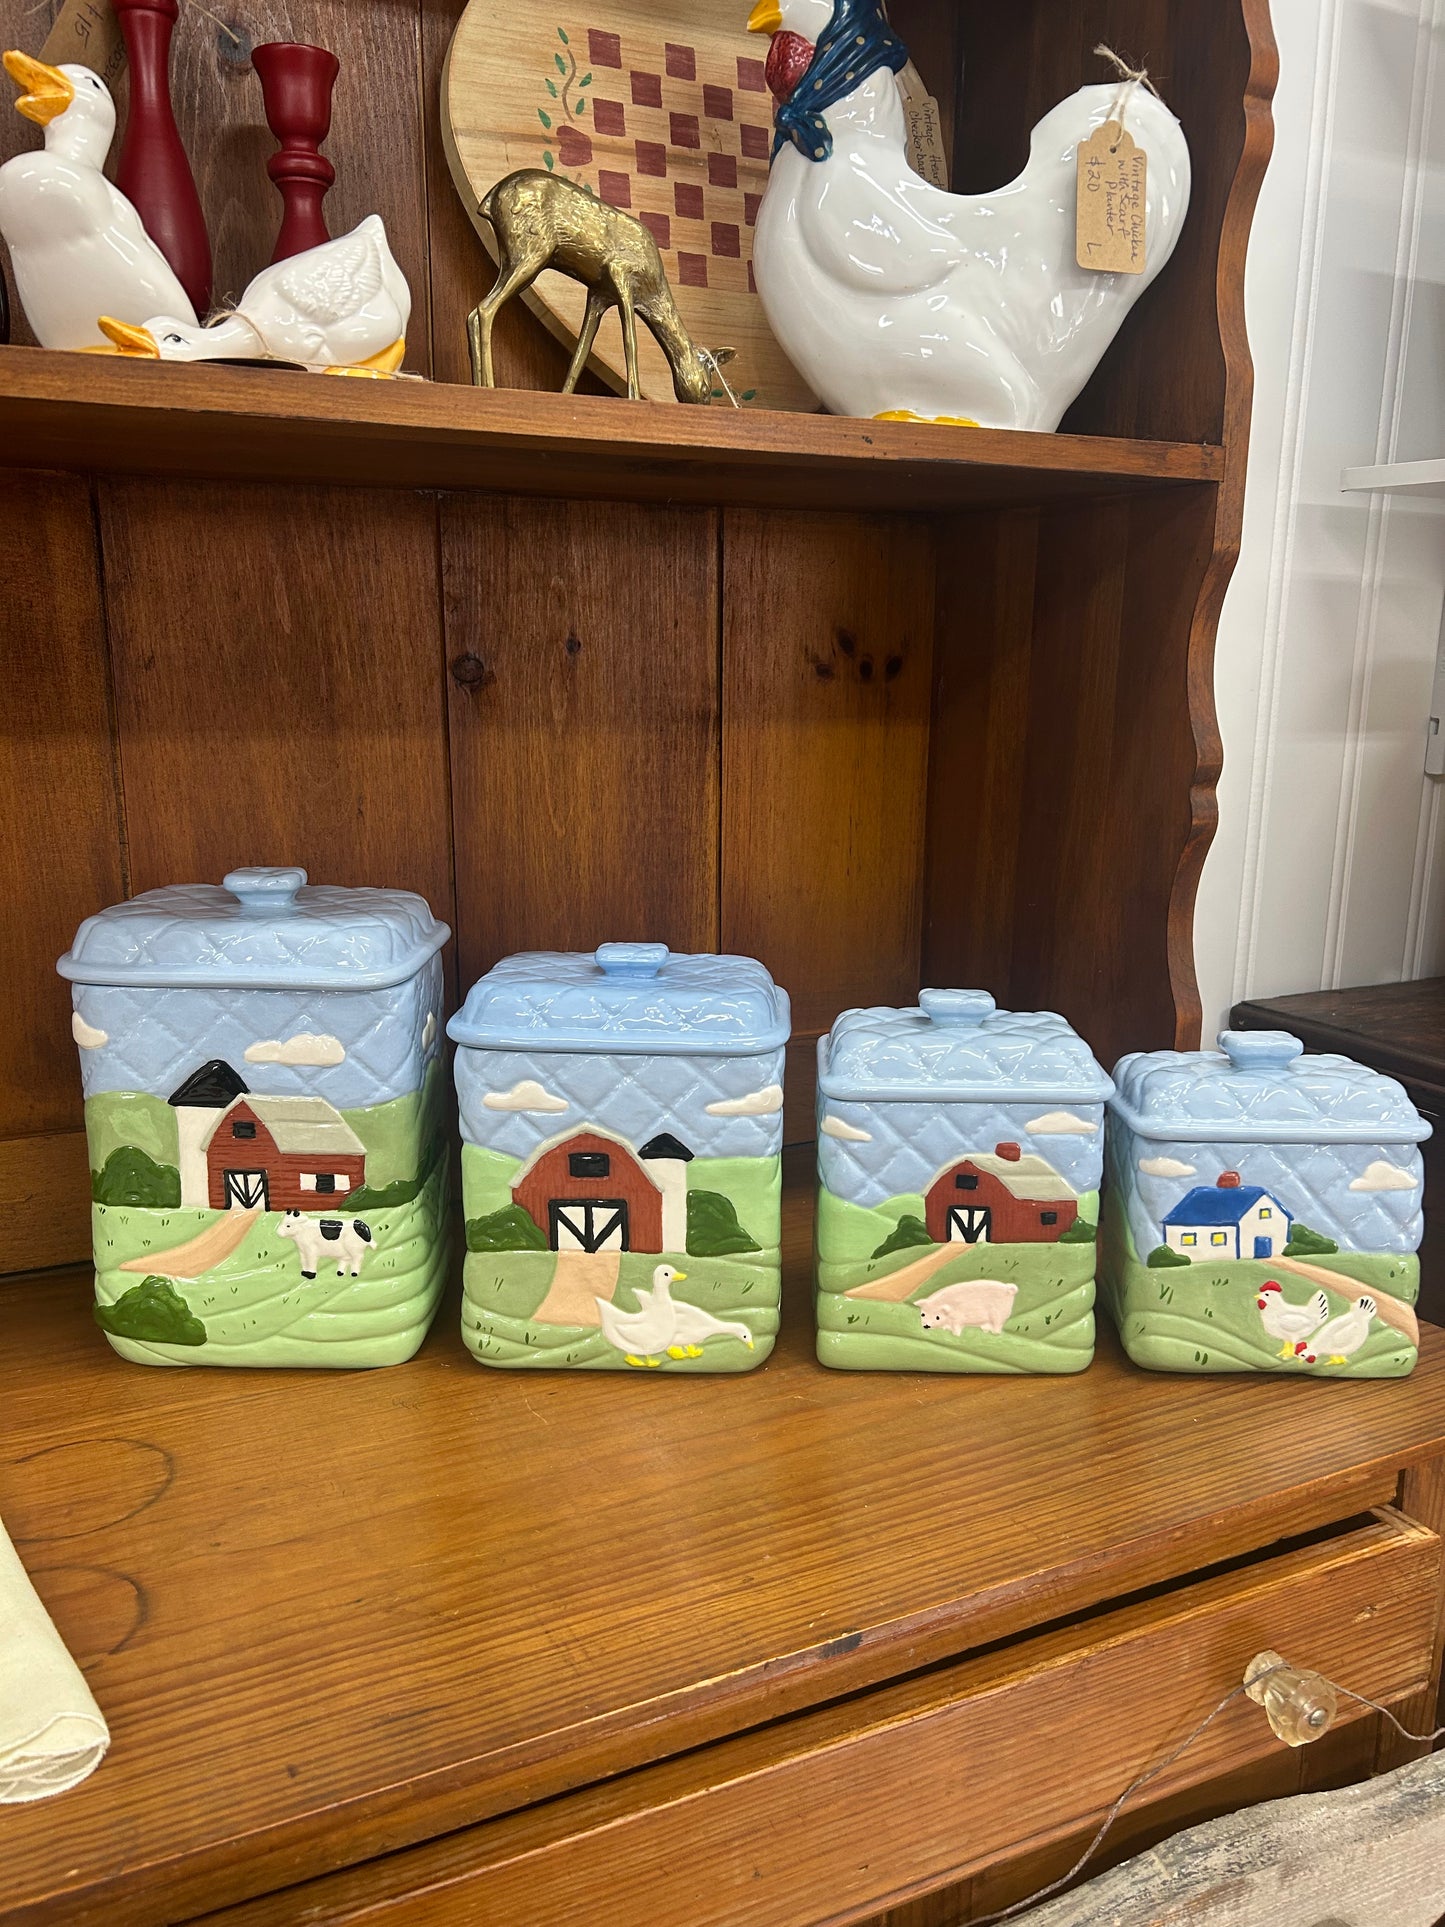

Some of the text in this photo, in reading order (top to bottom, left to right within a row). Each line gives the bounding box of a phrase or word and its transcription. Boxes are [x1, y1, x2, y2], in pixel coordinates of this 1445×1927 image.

[922, 102, 945, 187] Vintage Heart
[1085, 156, 1106, 192] $20
[1105, 181, 1117, 236] Planter
[1118, 160, 1130, 239] with Scarf
[1131, 157, 1143, 264] Vintage Chicken
